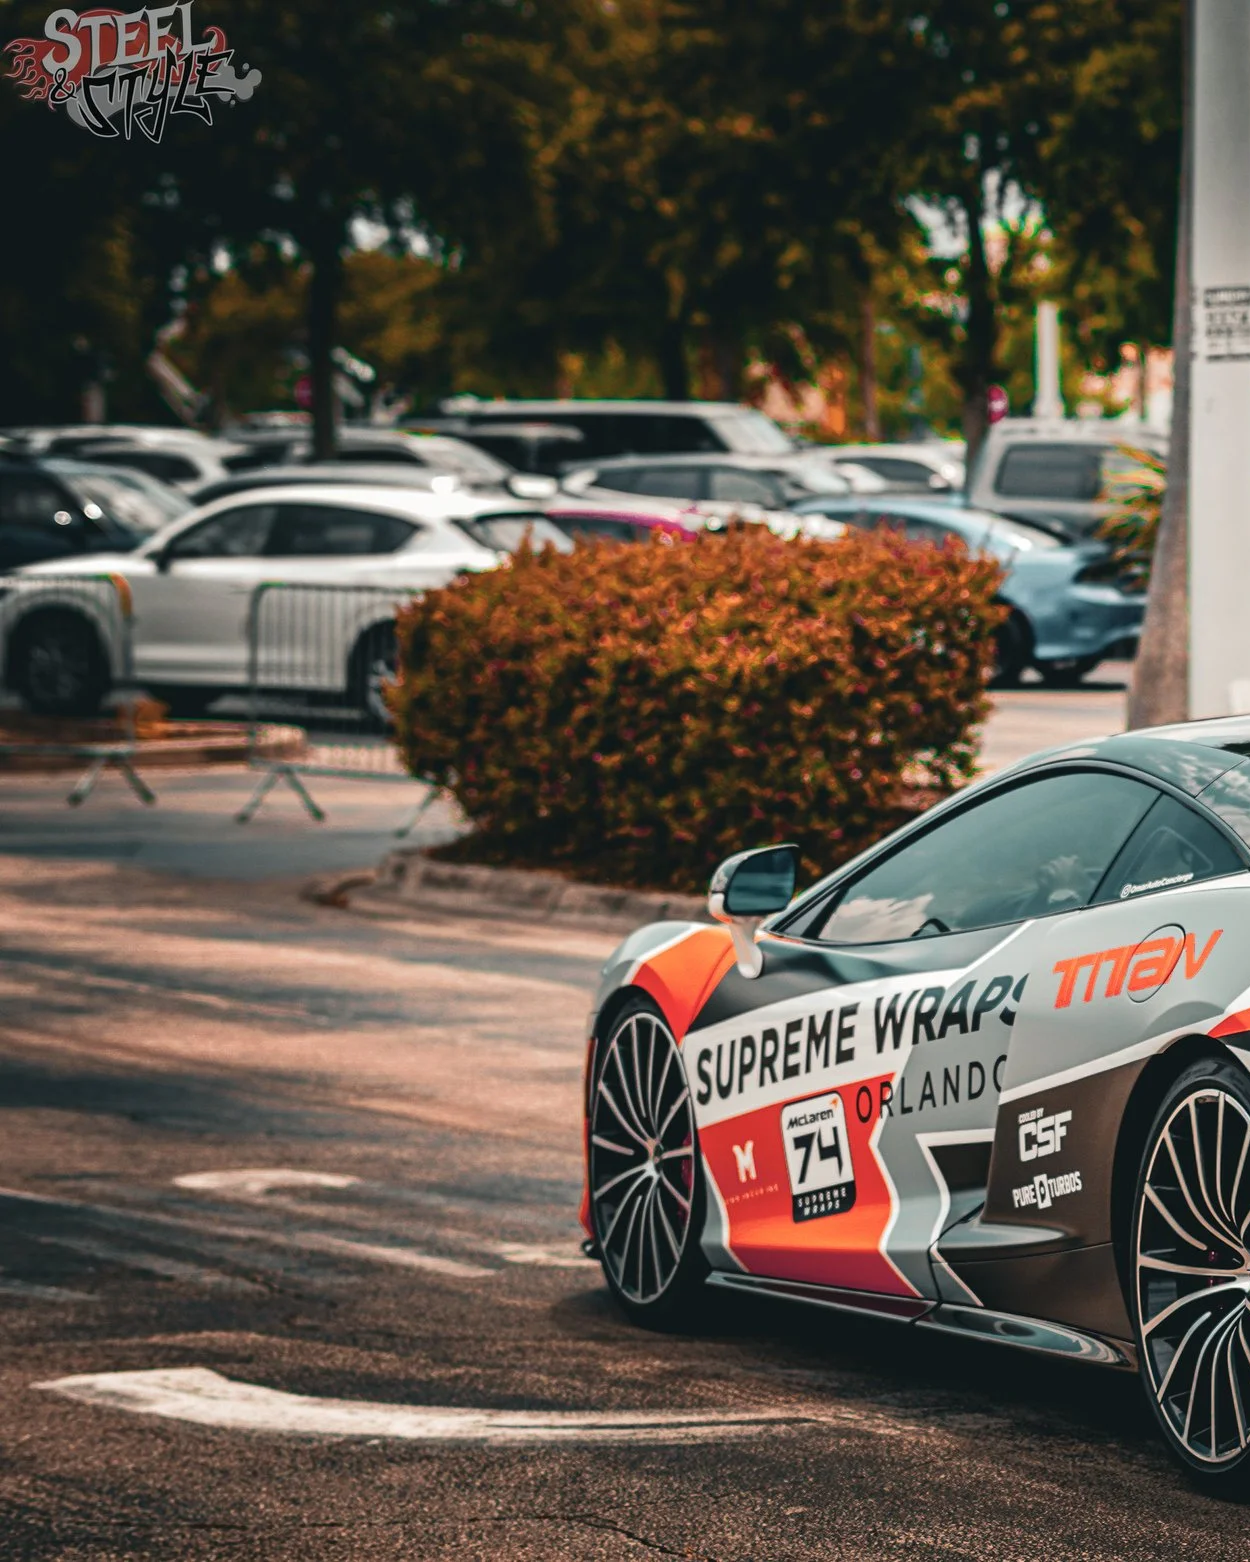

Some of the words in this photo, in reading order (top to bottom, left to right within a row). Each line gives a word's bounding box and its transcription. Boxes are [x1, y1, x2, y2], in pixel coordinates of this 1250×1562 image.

[696, 1001, 861, 1106] SUPREME
[873, 973, 1031, 1054] WRAPS
[787, 1108, 834, 1131] McLaren
[1018, 1110, 1037, 1124] COOLED
[1036, 1107, 1045, 1119] BY
[1018, 1110, 1072, 1162] CSF
[793, 1126, 844, 1185] 74
[797, 1187, 847, 1208] SUPREME
[1012, 1184, 1037, 1208] PURE
[1047, 1171, 1083, 1198] TURBOS
[803, 1199, 841, 1216] WRAPS
